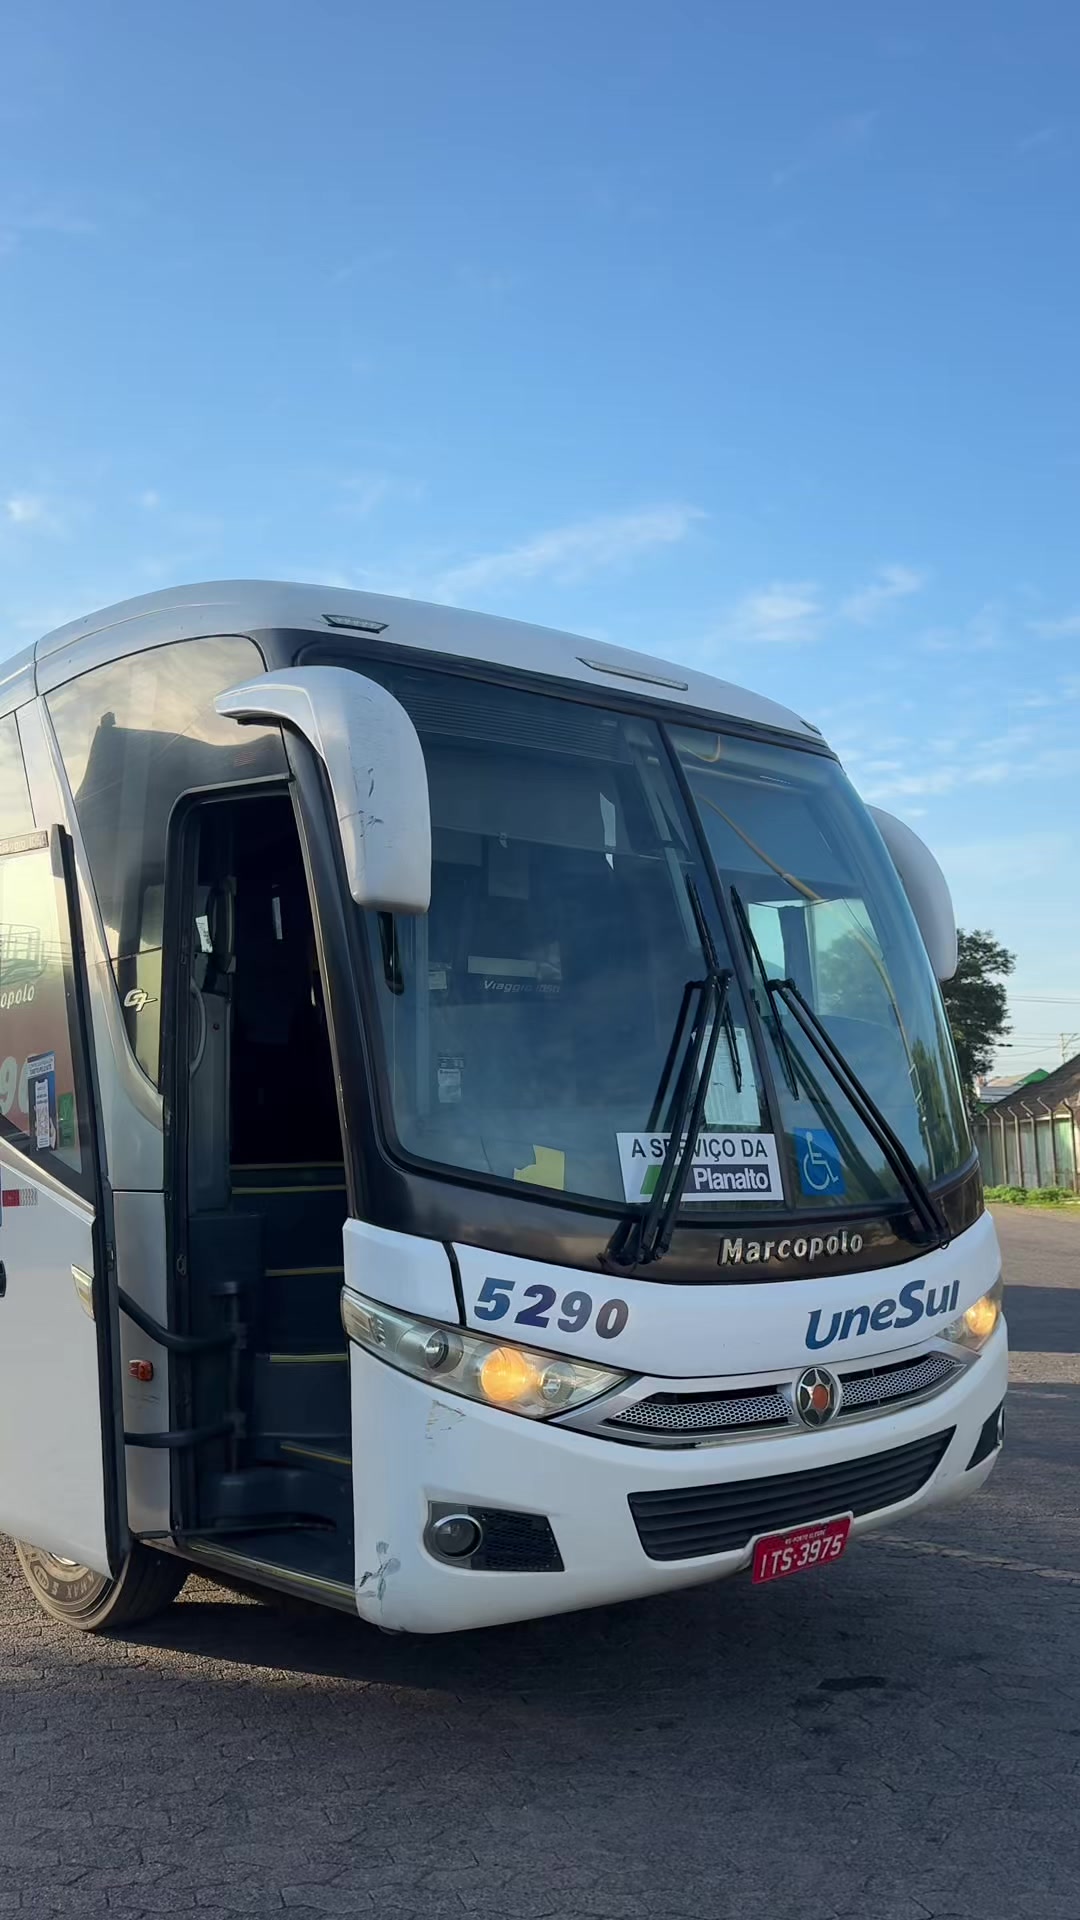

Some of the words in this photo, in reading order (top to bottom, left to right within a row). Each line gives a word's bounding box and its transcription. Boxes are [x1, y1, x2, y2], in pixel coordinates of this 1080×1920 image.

[631, 1138, 647, 1158] A
[741, 1138, 769, 1158] DA
[692, 1167, 769, 1190] Planalto
[718, 1229, 864, 1266] Marcopolo
[474, 1276, 629, 1340] 5290
[805, 1279, 960, 1350] UneSul
